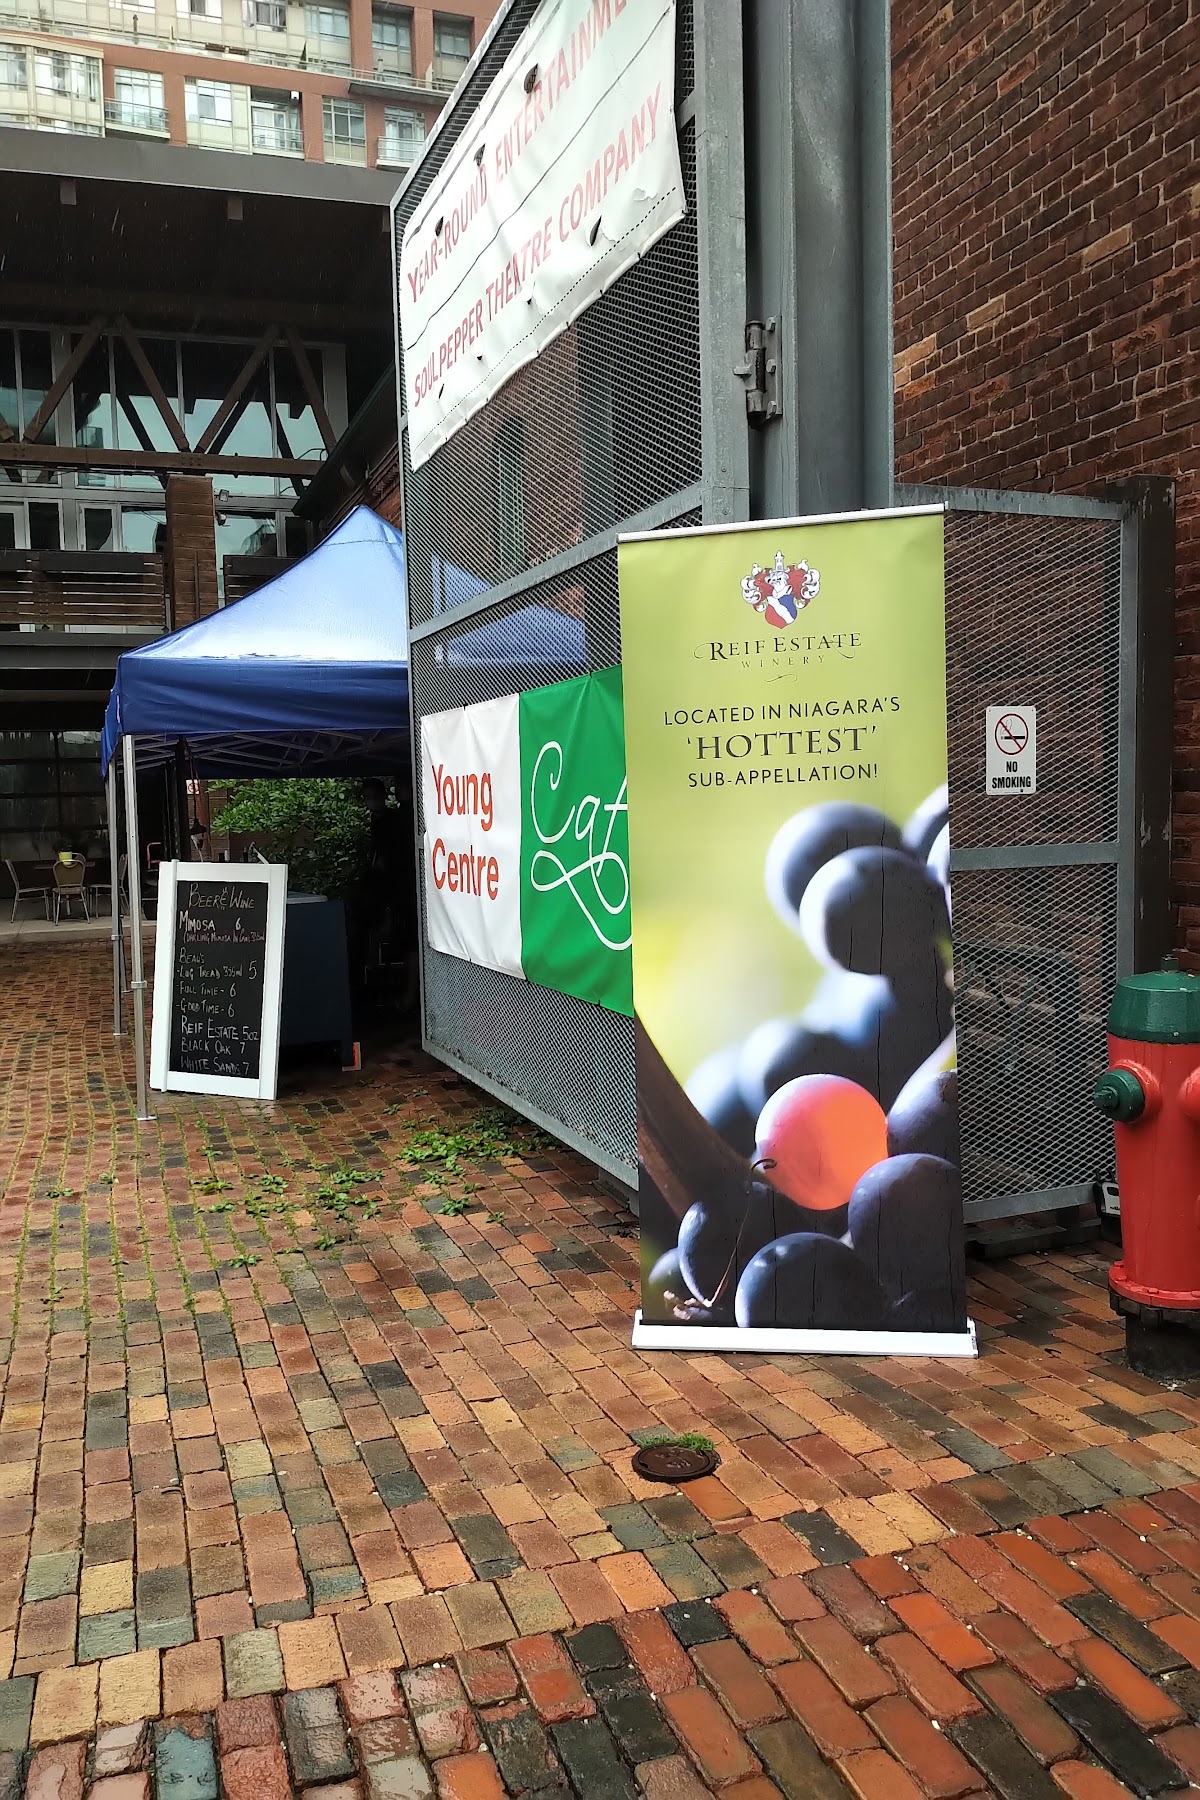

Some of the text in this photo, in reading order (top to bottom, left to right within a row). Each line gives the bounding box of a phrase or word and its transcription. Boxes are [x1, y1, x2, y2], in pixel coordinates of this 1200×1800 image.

[408, 164, 487, 302] YEAR-ROUND
[415, 81, 661, 407] SOULPEPPER THEATRE COMPANY
[702, 633, 862, 661] REIF ESTATE
[742, 655, 824, 668] WINERY
[664, 696, 900, 726] LOCATED IN NIAGARA'S
[688, 763, 878, 787] SUB-APPELLATION!
[1006, 761, 1018, 773] NO
[992, 776, 1031, 788] SMOKING
[432, 764, 493, 832] Young
[432, 838, 499, 901] Centre
[189, 882, 219, 908] BEER
[229, 886, 255, 909] WINE
[179, 910, 241, 933] MIMOSA 6
[198, 965, 220, 979] TREAD
[249, 960, 257, 980] 5
[229, 983, 236, 997] 6
[228, 1003, 235, 1018] 6
[182, 1015, 204, 1035] REIF
[208, 1017, 239, 1040] ESTATE
[181, 1037, 246, 1055] BLACK OAK 7
[181, 1056, 210, 1072] WHITE
[242, 1061, 250, 1075] 7
